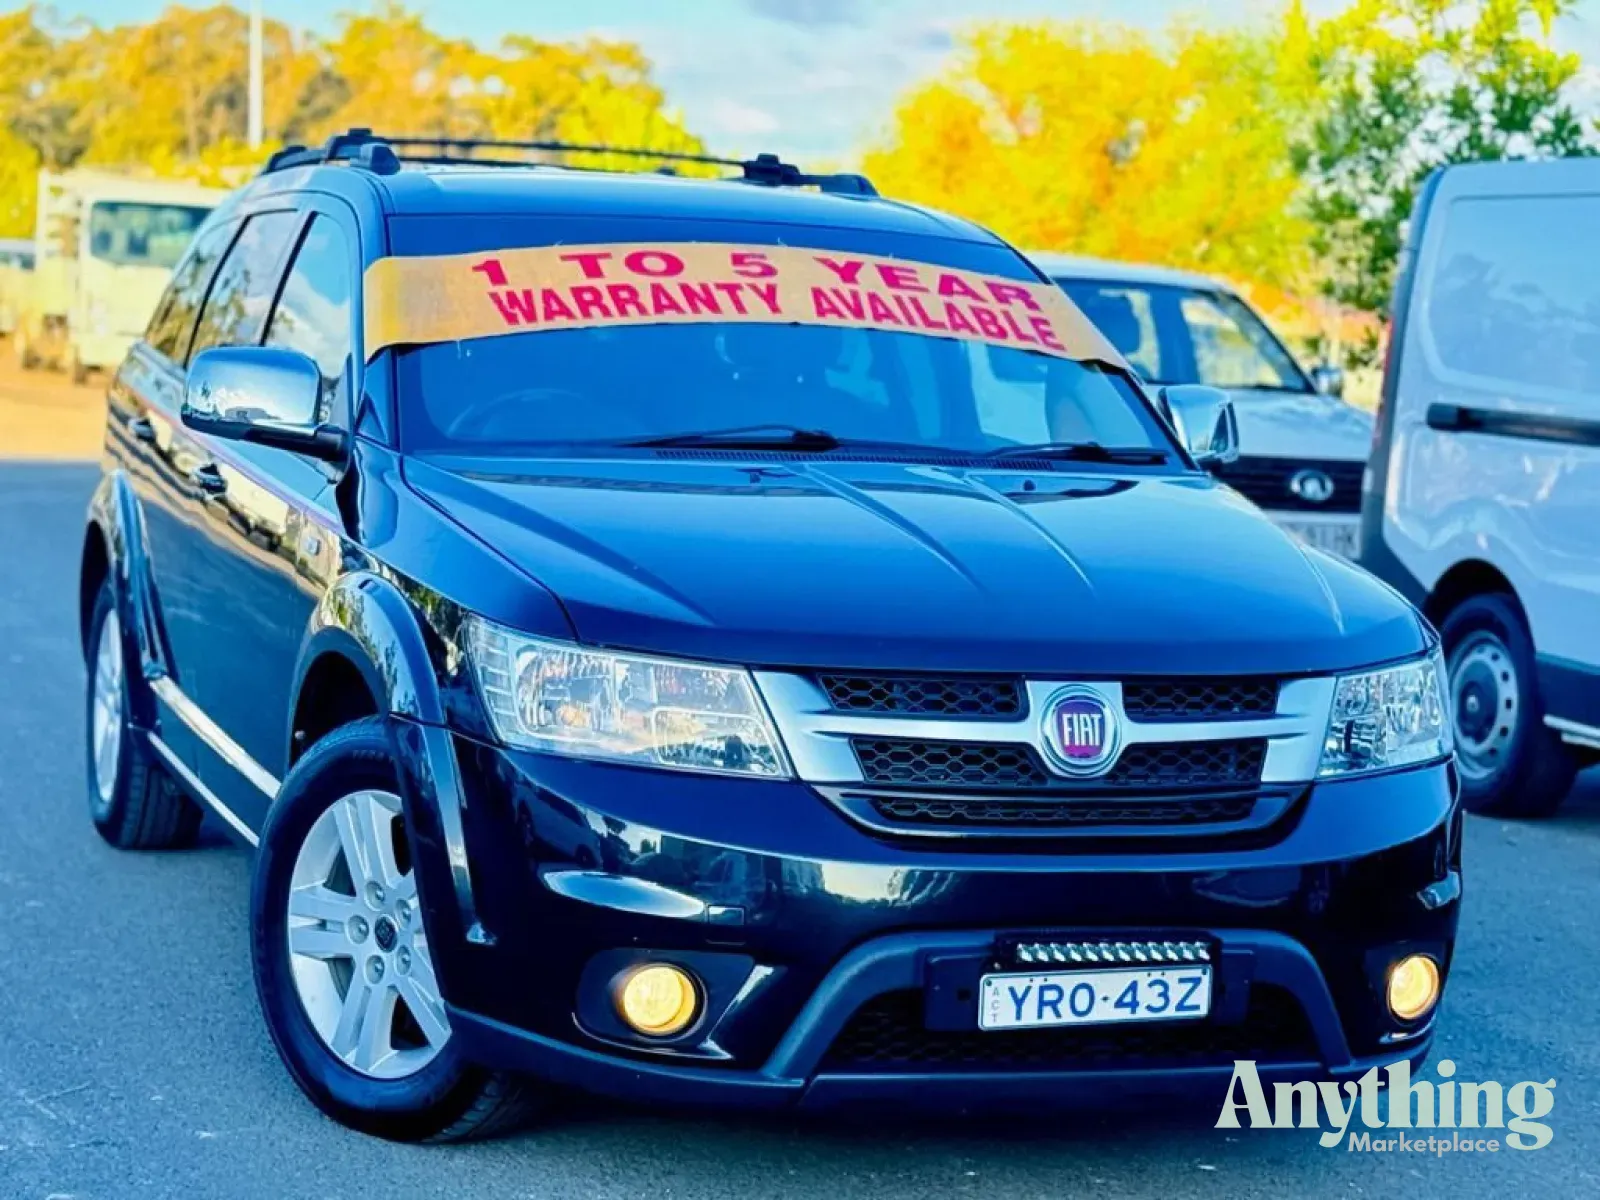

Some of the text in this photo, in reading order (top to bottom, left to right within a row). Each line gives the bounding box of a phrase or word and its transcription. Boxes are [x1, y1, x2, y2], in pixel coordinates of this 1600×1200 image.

[471, 251, 1043, 313] 1 TO 5 YEAR
[487, 282, 1066, 352] WARRANTY AVAILABLE
[1062, 712, 1102, 746] FIAT
